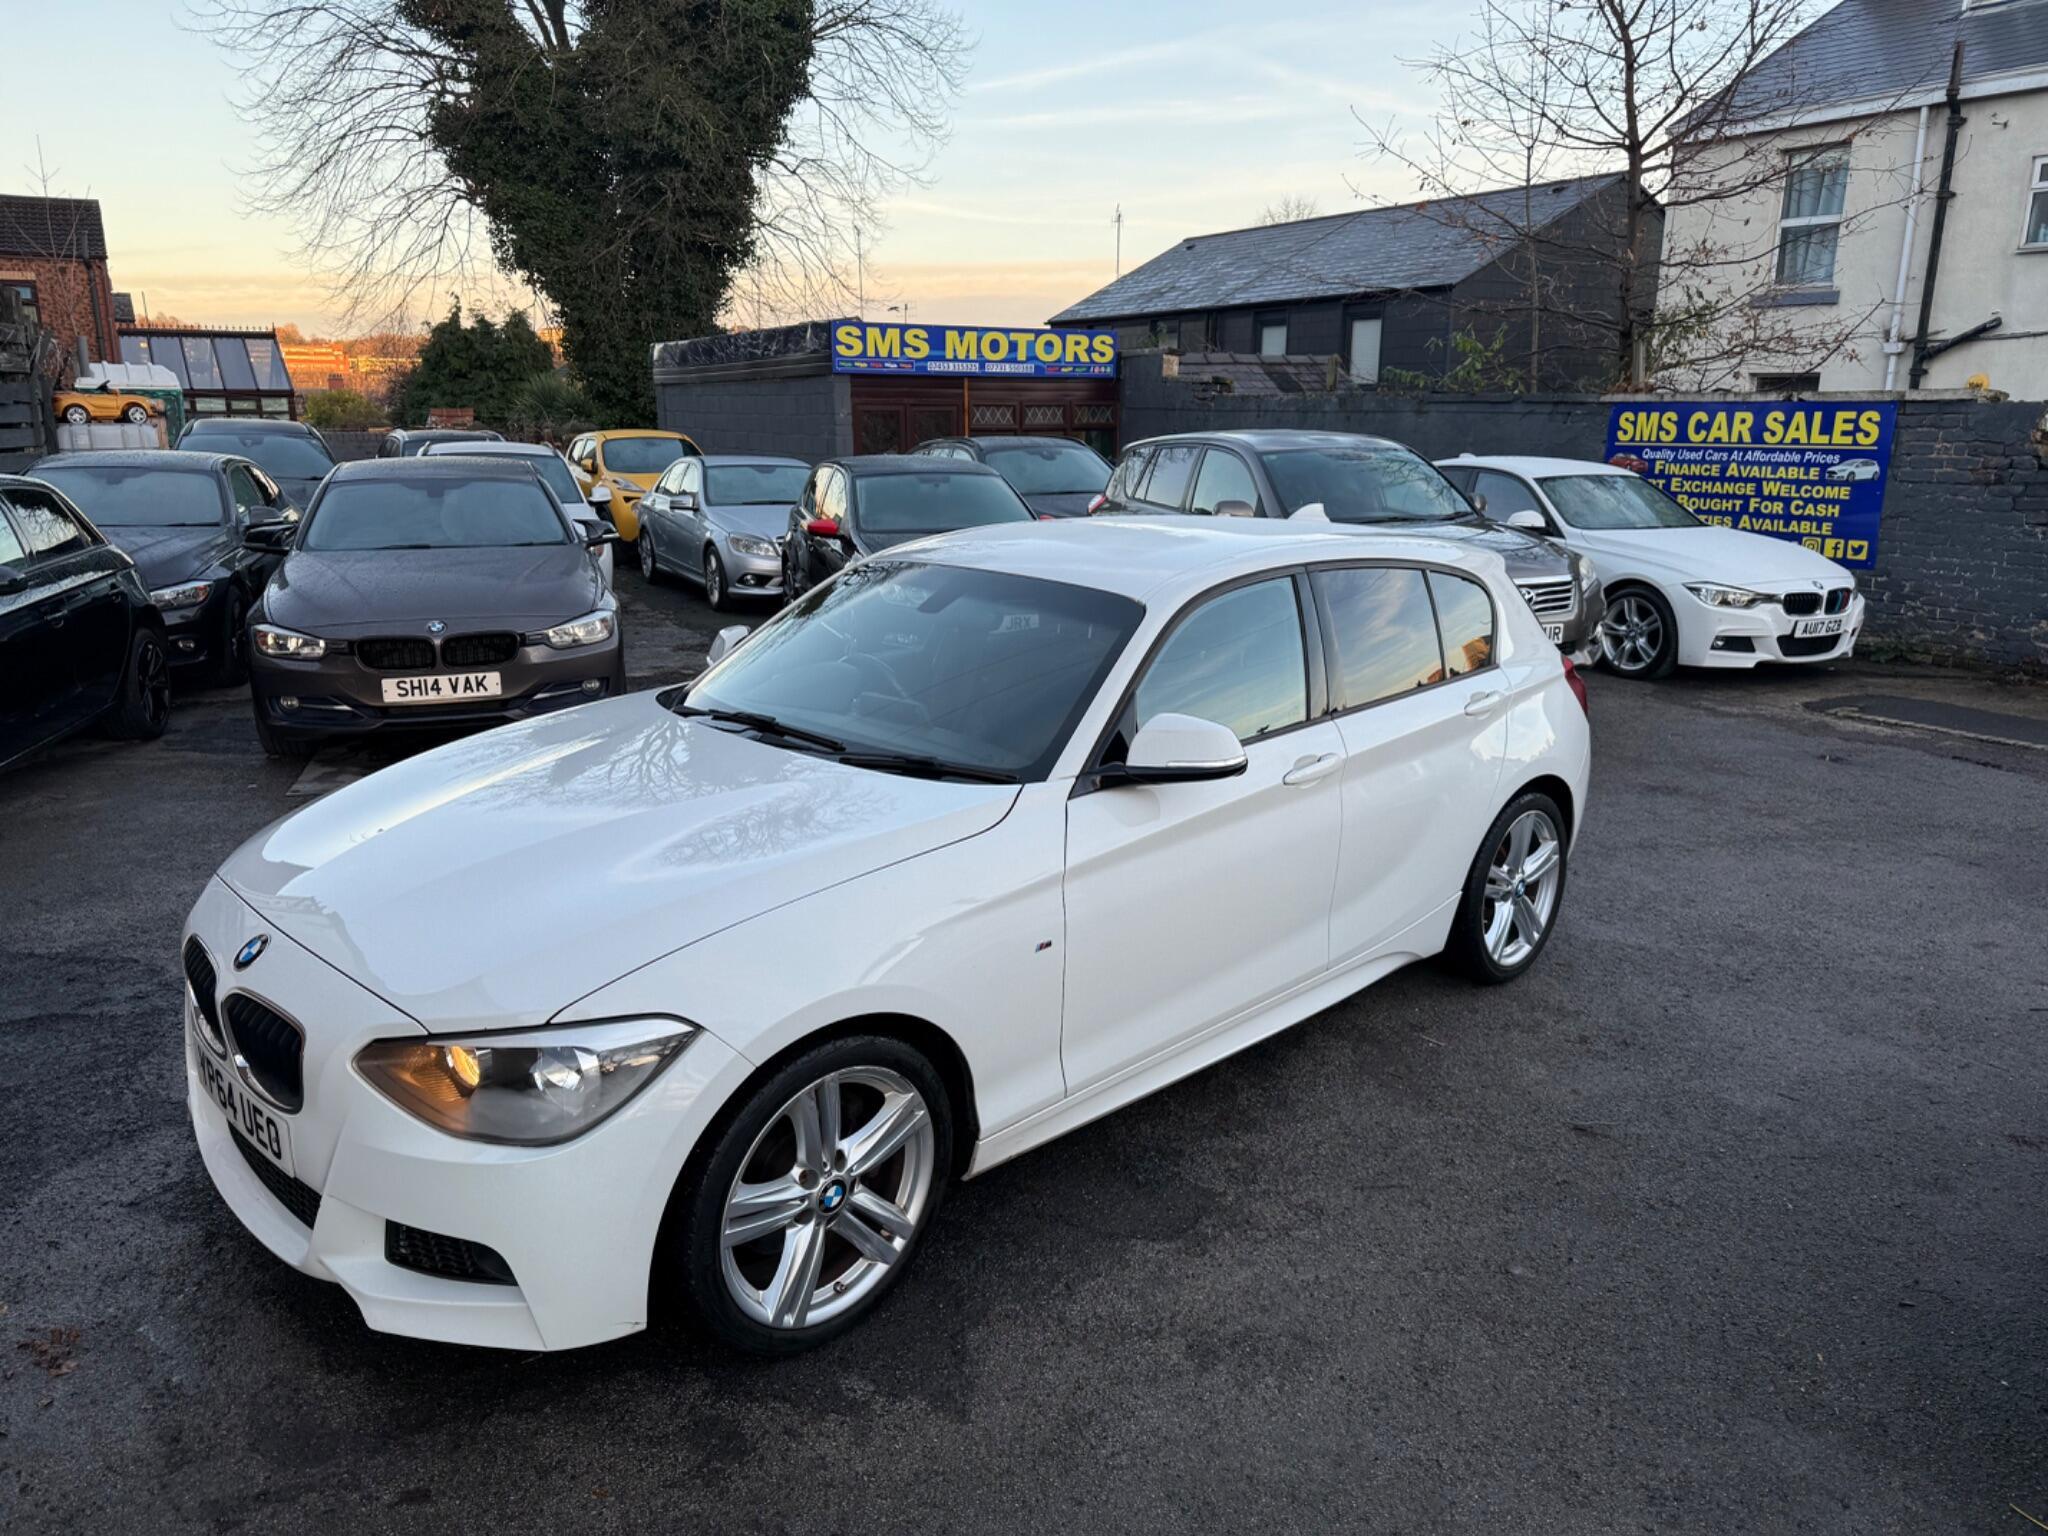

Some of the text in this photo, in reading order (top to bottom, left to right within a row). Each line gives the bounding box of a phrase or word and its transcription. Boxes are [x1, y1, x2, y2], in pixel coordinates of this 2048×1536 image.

[835, 325, 1115, 363] SMS MOTORS
[1616, 410, 1881, 446] SMS CAR SALES
[1642, 448, 1841, 464] Quality Used Cars At Affordable Prices
[1654, 460, 1820, 480] FINANCE AVAILABLE
[1670, 478, 1757, 496] EXCHANGE
[1762, 481, 1851, 500] WELCOME
[1676, 494, 1841, 518] BOUGHT FOR CASH
[1737, 515, 1834, 536] AVAILABLE
[396, 675, 489, 698] SH14 VAK
